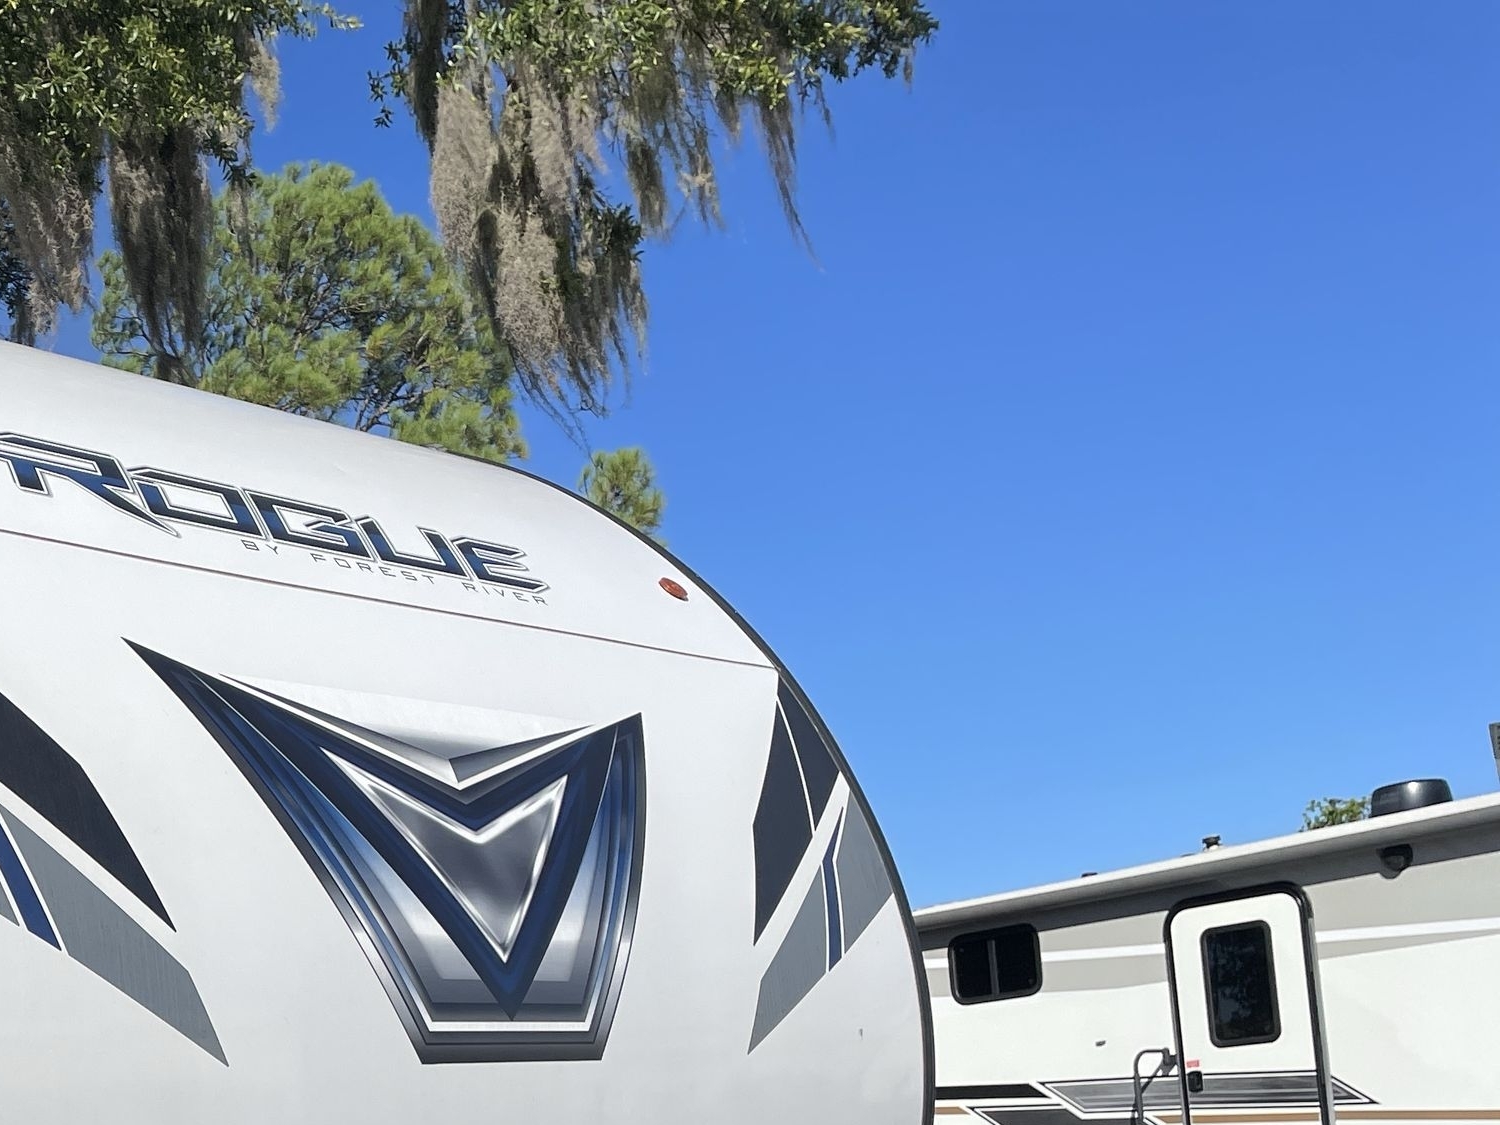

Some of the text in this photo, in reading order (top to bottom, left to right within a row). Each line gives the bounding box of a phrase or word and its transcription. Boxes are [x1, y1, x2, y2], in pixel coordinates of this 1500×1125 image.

[241, 538, 549, 606] BY FOREST RIVER
